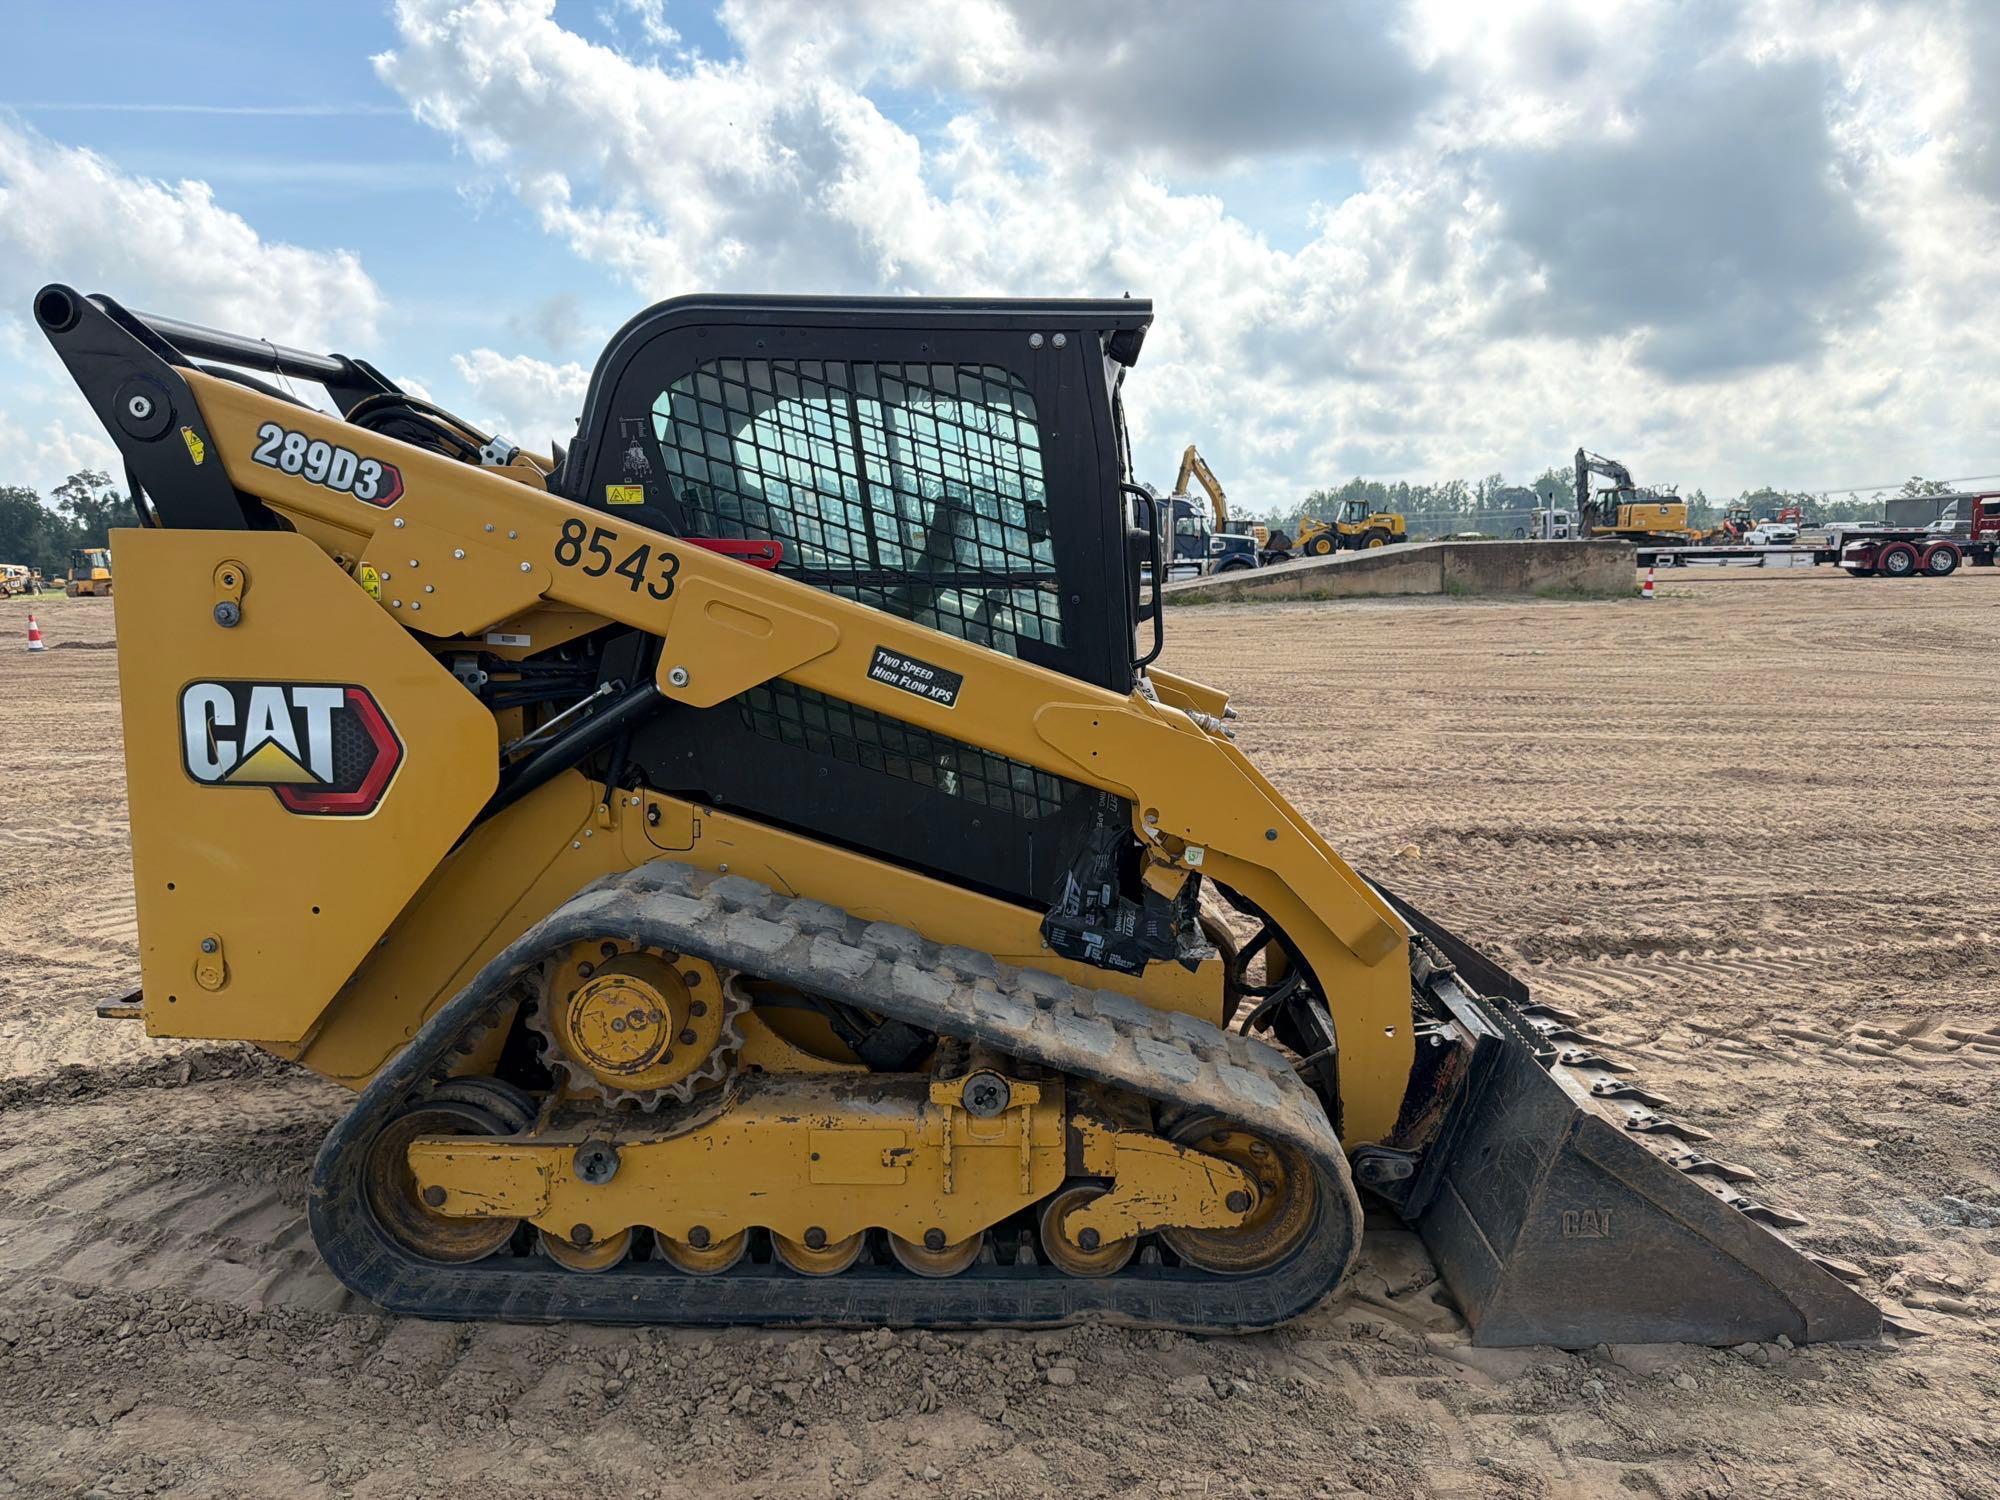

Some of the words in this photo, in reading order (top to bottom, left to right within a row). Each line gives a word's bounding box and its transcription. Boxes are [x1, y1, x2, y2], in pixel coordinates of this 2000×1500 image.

[253, 423, 383, 500] 289D3
[554, 518, 680, 600] 8543
[872, 666, 899, 683] HIGH
[899, 675, 929, 694] FLOW
[928, 686, 953, 702] XPS
[877, 651, 900, 669] TWO
[901, 661, 934, 680] SPEED
[183, 682, 344, 784] CAT
[1562, 1208, 1614, 1238] CAT
